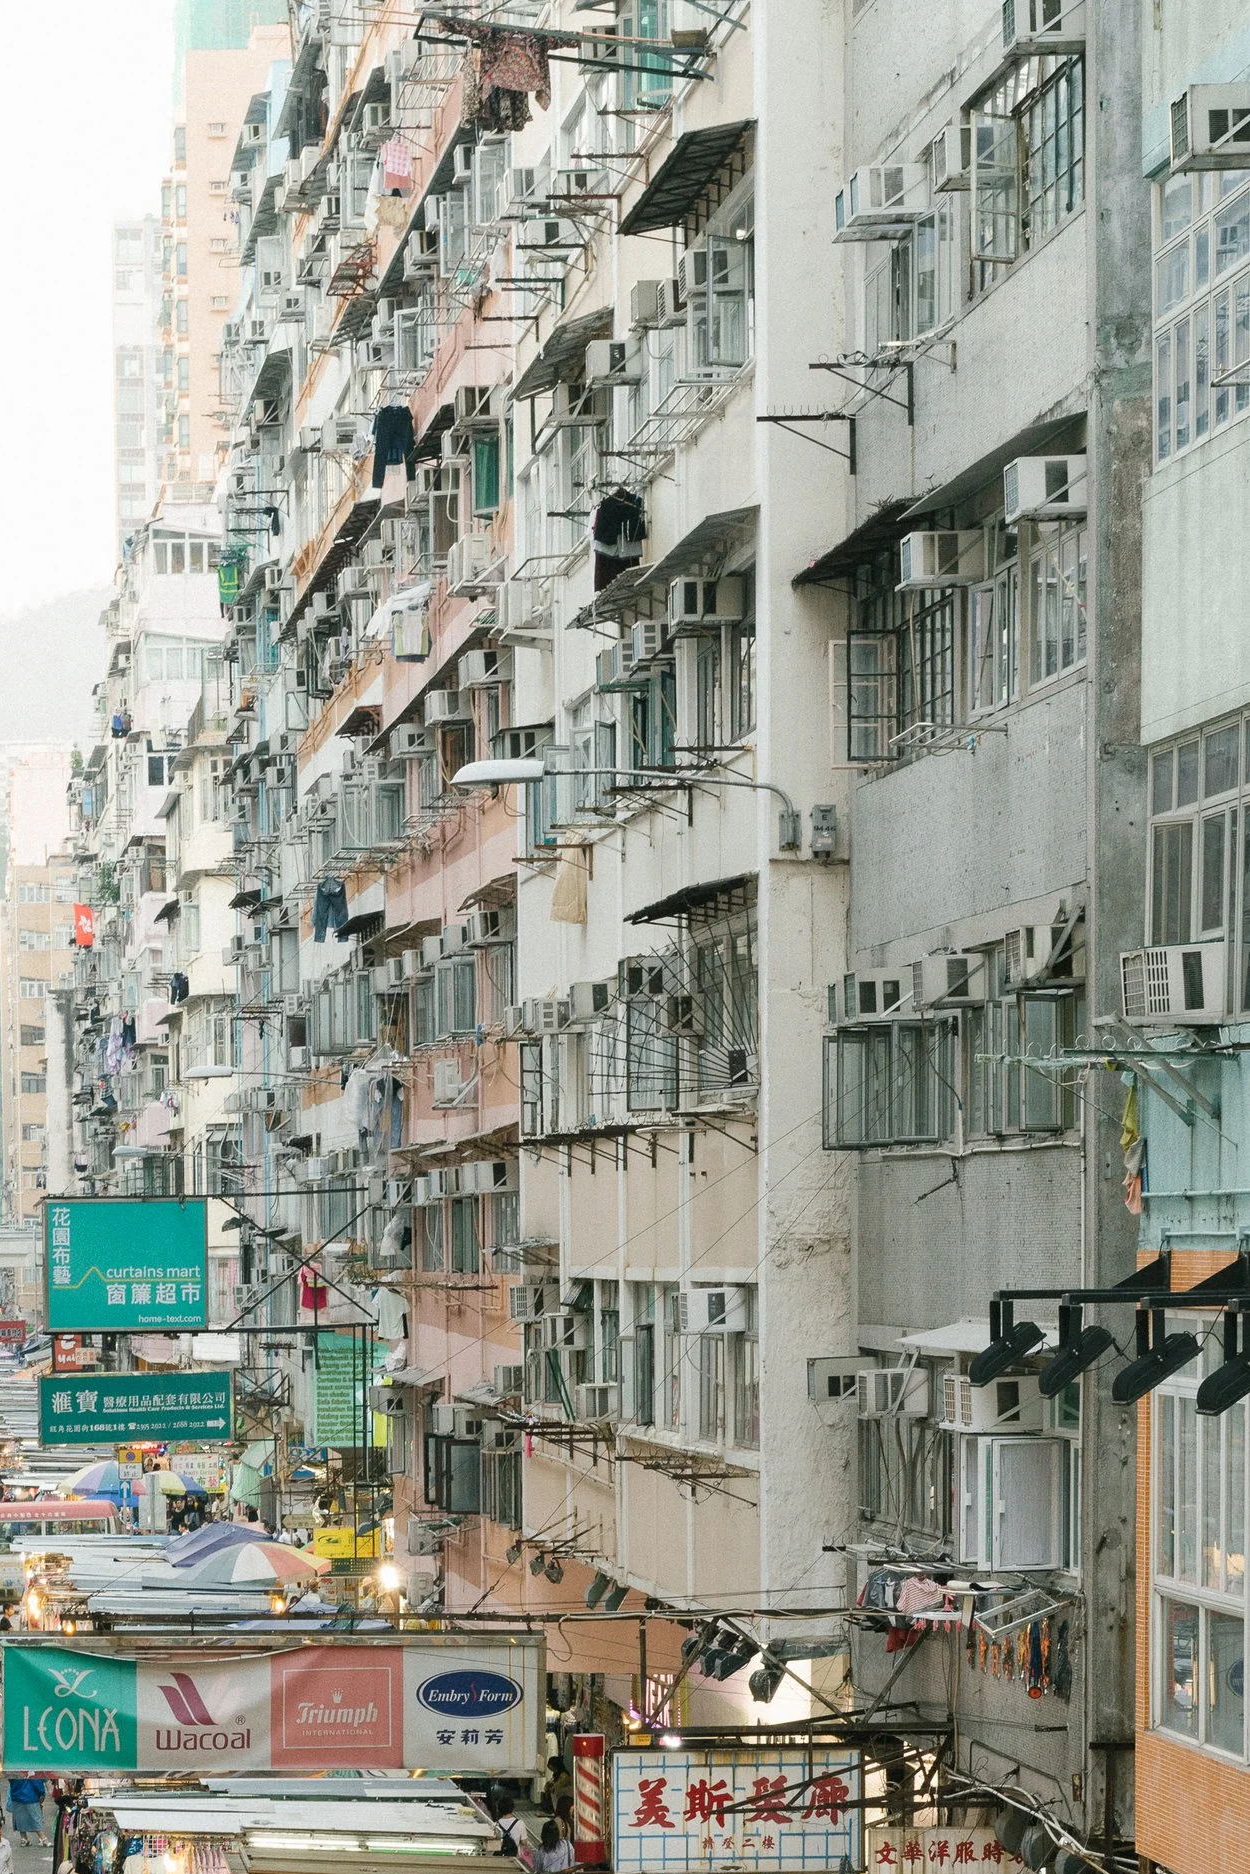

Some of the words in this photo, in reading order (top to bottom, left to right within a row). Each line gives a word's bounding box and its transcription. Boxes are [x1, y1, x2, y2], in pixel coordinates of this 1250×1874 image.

[52, 1207, 71, 1285] 花園布藝
[106, 1265, 163, 1279] curtains
[166, 1265, 200, 1278] mart
[106, 1282, 201, 1306] 窗簾超市
[138, 1314, 202, 1324] home-text.com
[428, 1689, 470, 1704] Embry
[478, 1689, 513, 1702] Form
[296, 1702, 379, 1727] Triumph
[23, 1705, 121, 1752] LEONA
[155, 1728, 251, 1751] Wacoal
[302, 1729, 374, 1737] INTERNATIONAL
[436, 1729, 504, 1746] 安莉芳
[628, 1772, 850, 1828] 美斯髮廊
